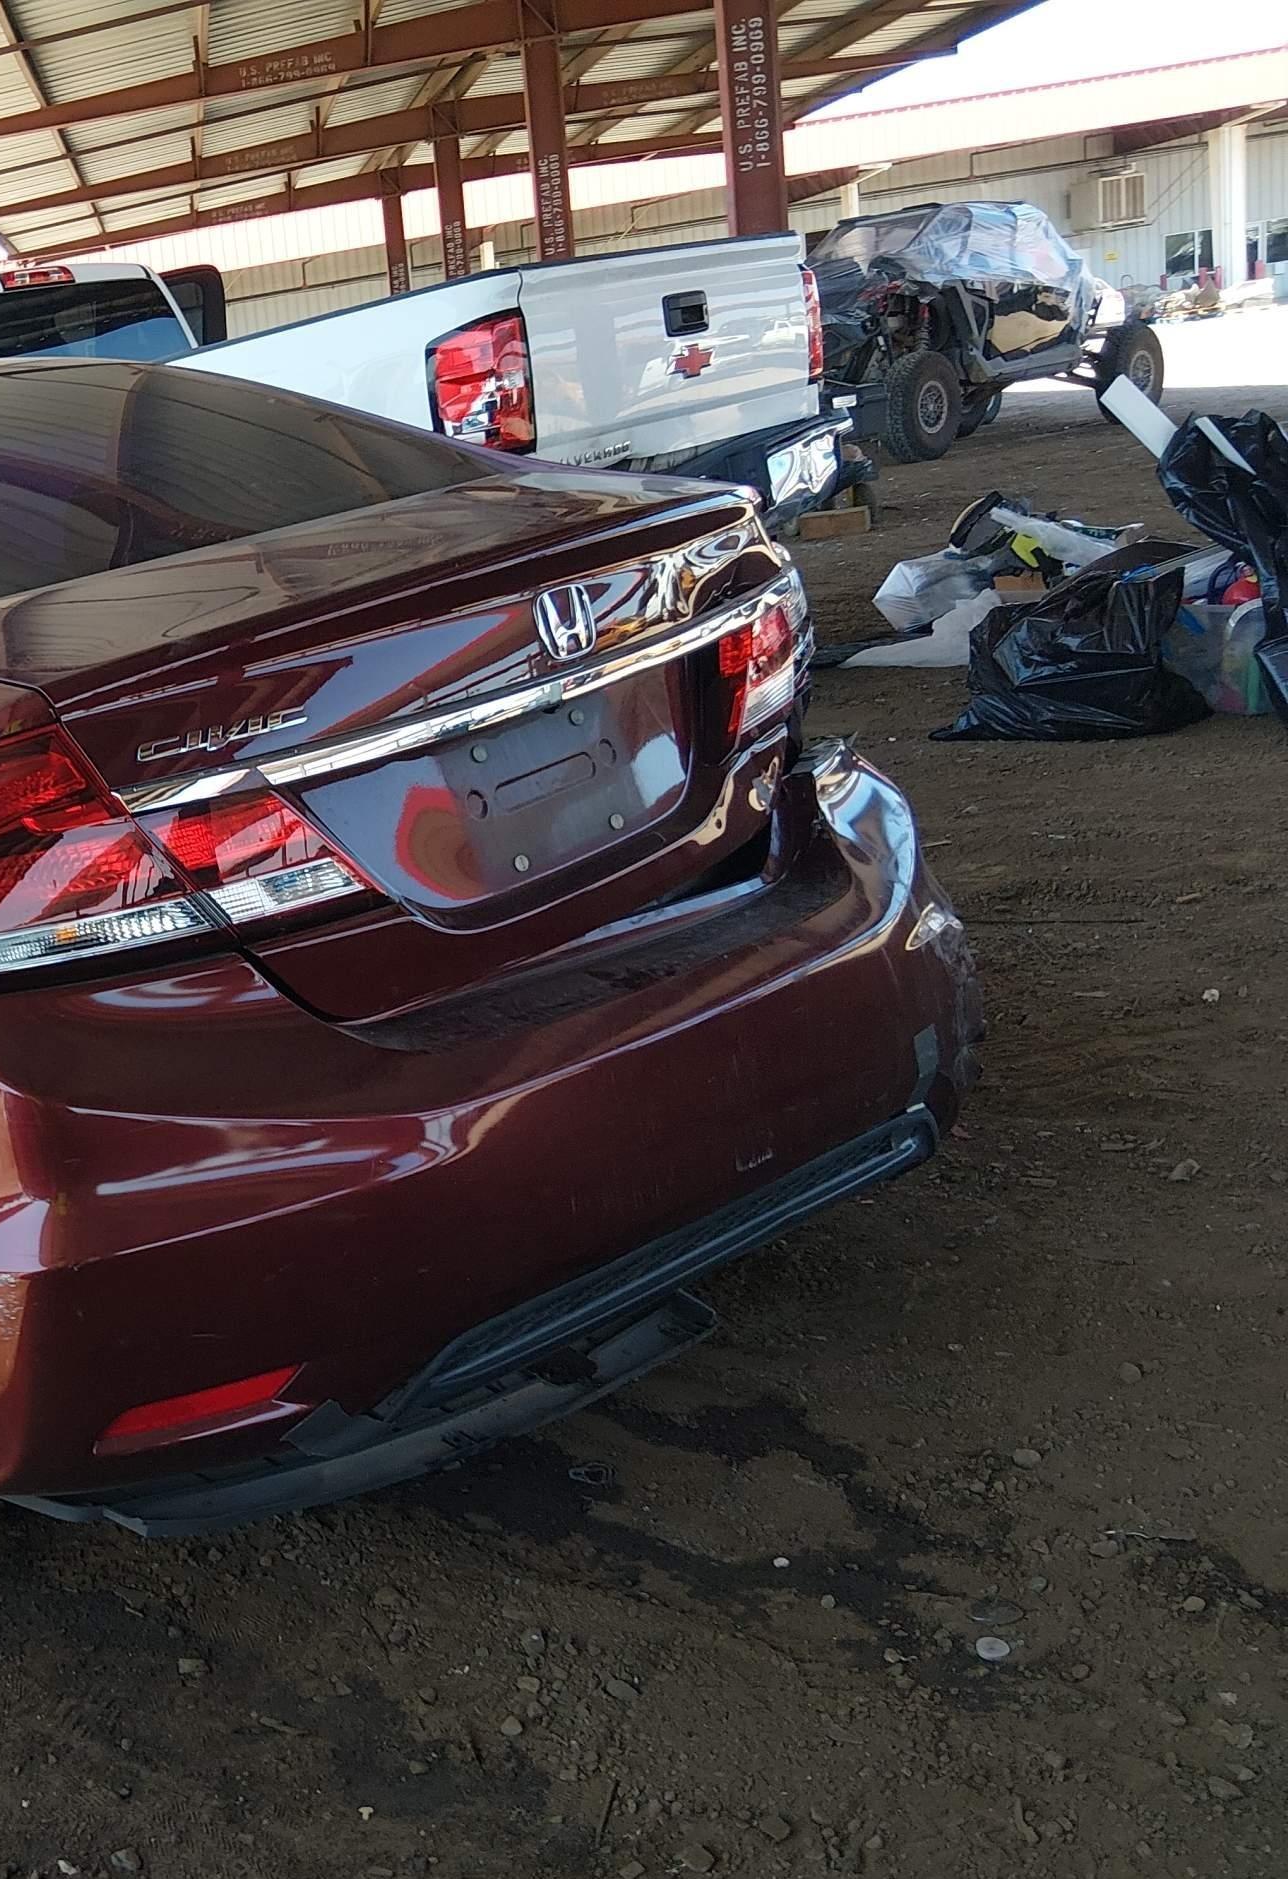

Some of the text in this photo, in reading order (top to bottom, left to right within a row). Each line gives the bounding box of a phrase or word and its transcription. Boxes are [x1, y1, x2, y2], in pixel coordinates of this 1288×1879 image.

[731, 18, 754, 172] U.S. PREFAB INC.
[748, 16, 771, 168] 1-866-799-0969
[137, 705, 309, 763] CIVIC
